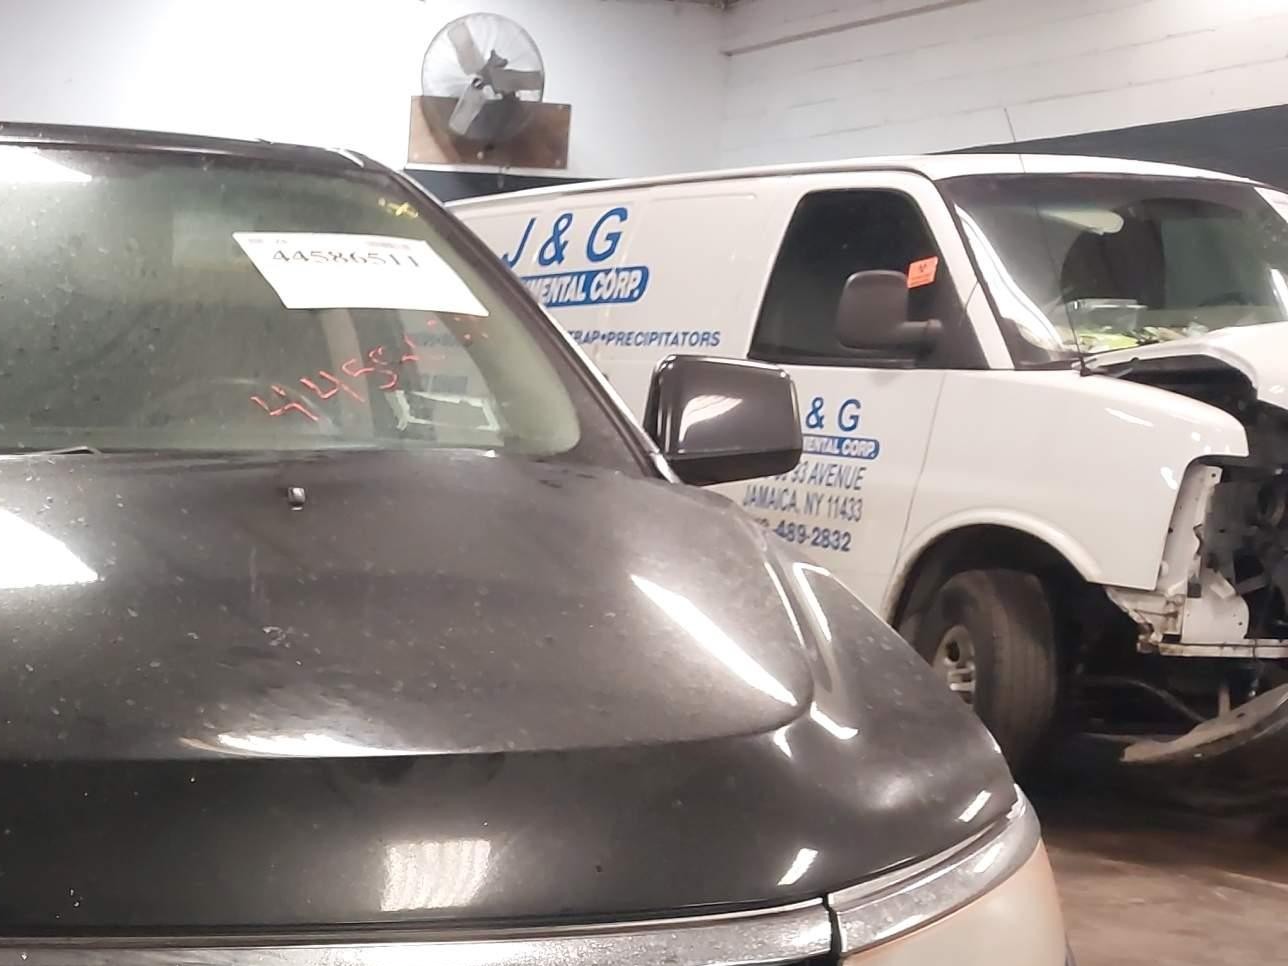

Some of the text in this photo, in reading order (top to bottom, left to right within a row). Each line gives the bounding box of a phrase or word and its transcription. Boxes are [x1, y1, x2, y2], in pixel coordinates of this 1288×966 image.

[501, 207, 629, 268] J & G
[271, 249, 420, 268] 44586511
[526, 270, 642, 304] MENTAL CORP.
[806, 397, 862, 432] & G
[842, 439, 876, 458] CORP.
[807, 463, 867, 491] AVENUE
[803, 493, 824, 516] NY
[827, 496, 864, 523] 11433
